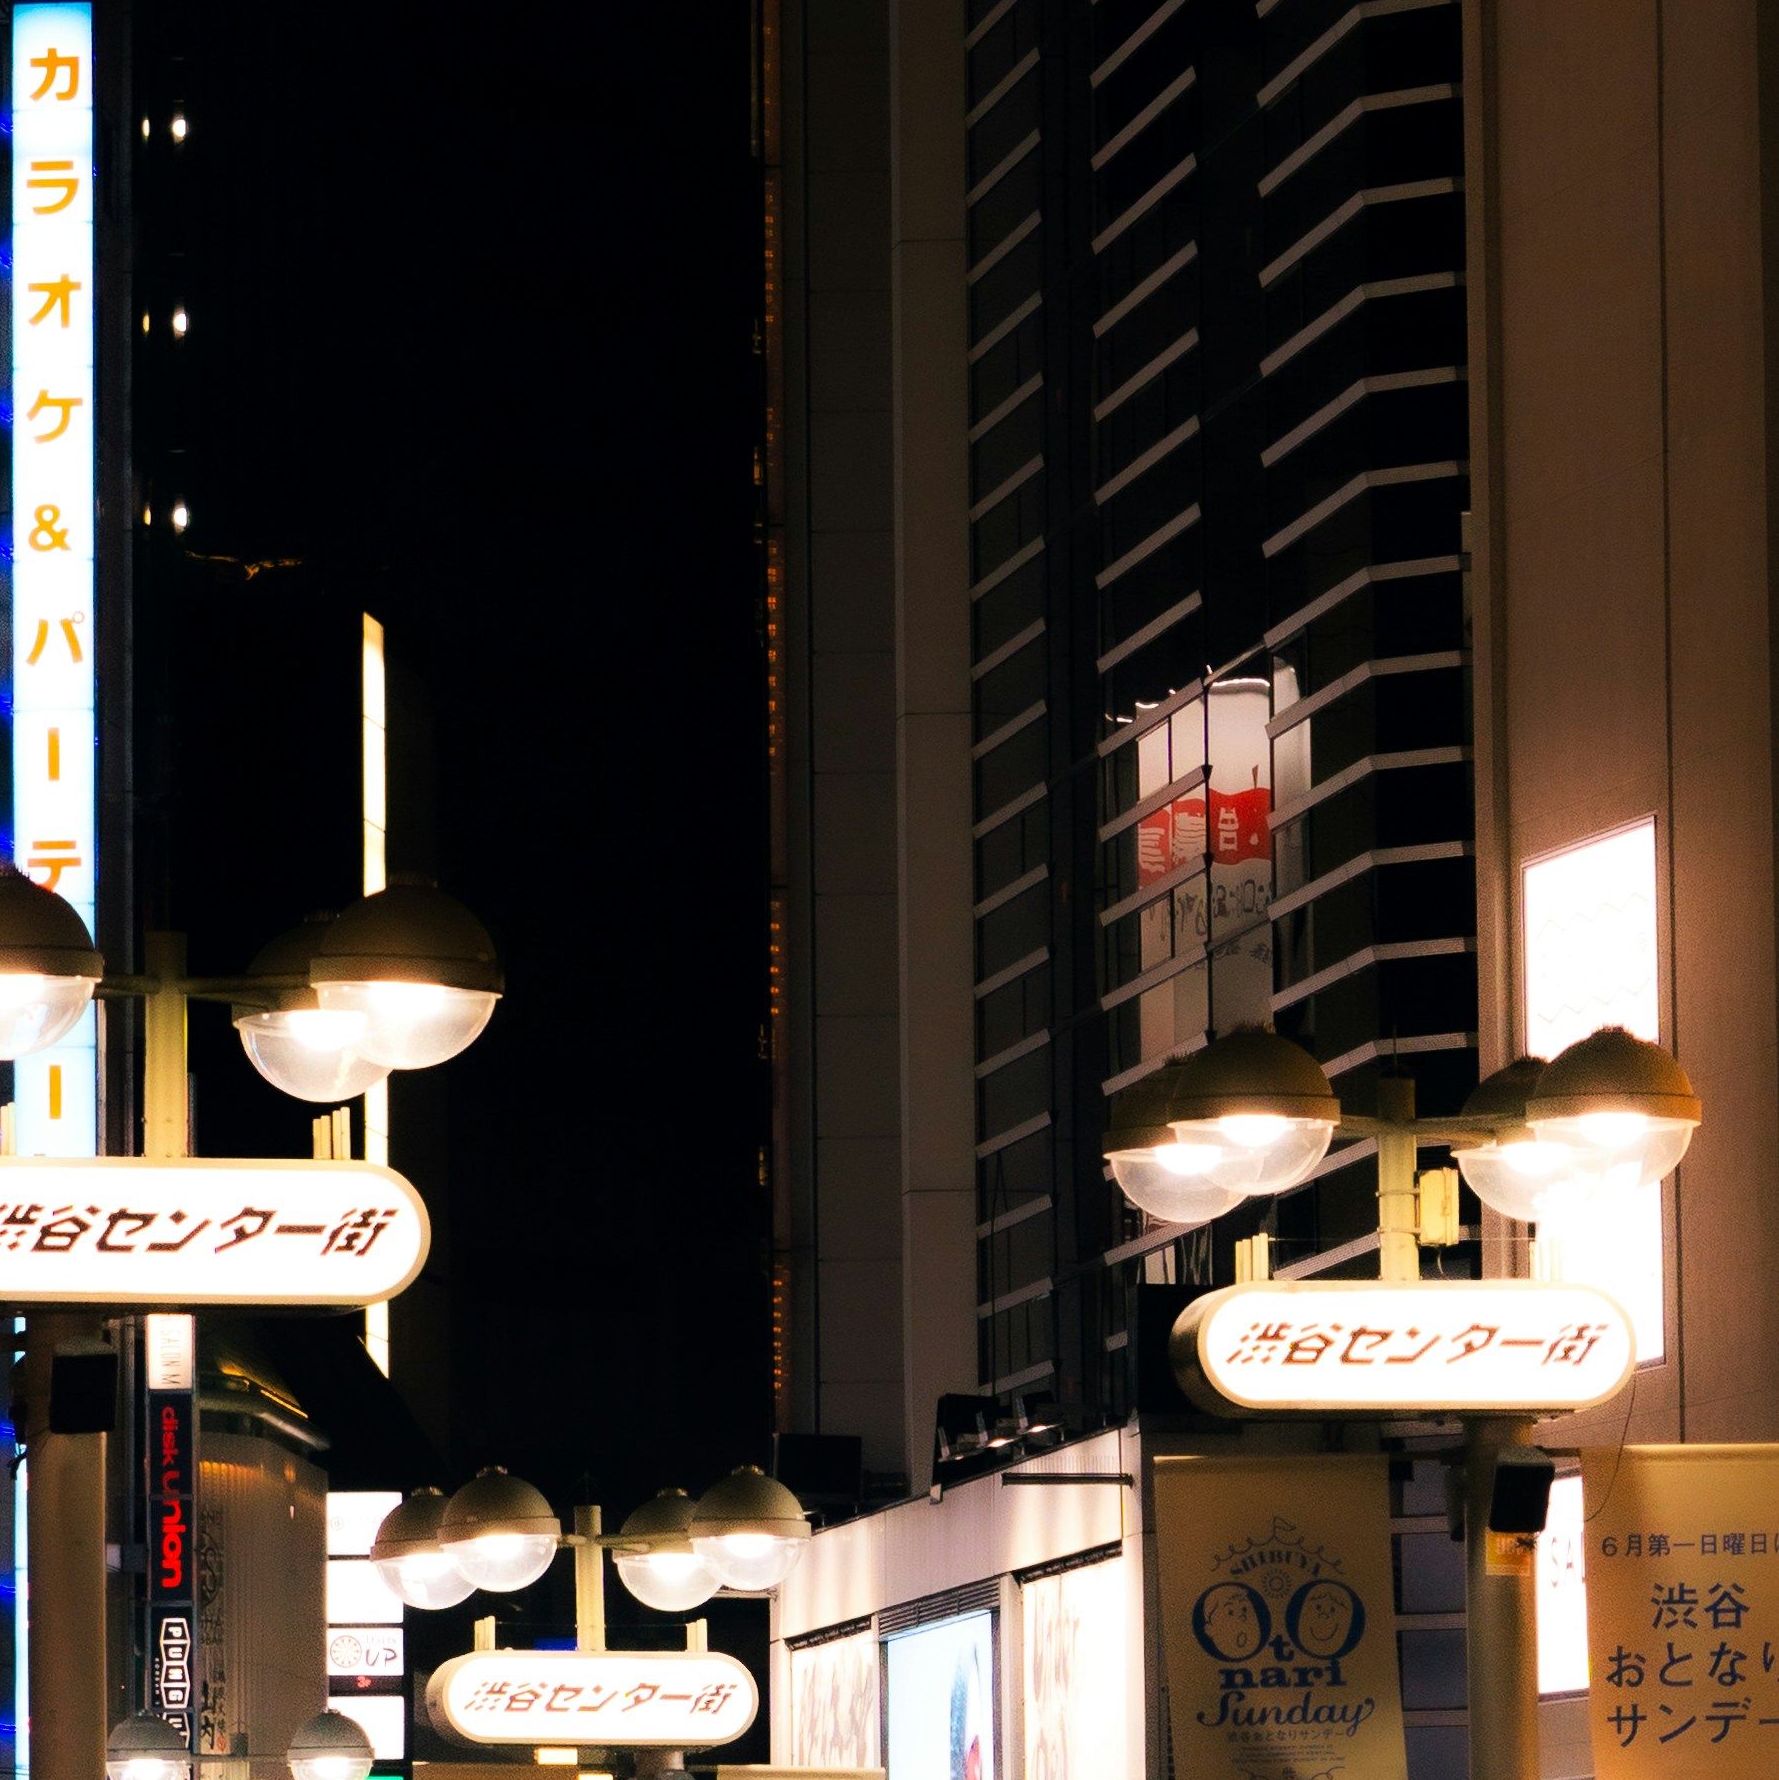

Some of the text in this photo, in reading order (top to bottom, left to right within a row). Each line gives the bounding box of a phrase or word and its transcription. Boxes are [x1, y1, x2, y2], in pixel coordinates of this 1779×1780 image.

[1226, 1320, 1611, 1367] 渋谷センター街
[161, 1406, 187, 1588] disk union
[1651, 1582, 1750, 1631] 渋谷
[365, 1648, 398, 1668] UP
[1219, 1660, 1349, 1691] nari
[462, 1679, 739, 1715] 渋谷センター街
[1195, 1691, 1376, 1736] Sunday
